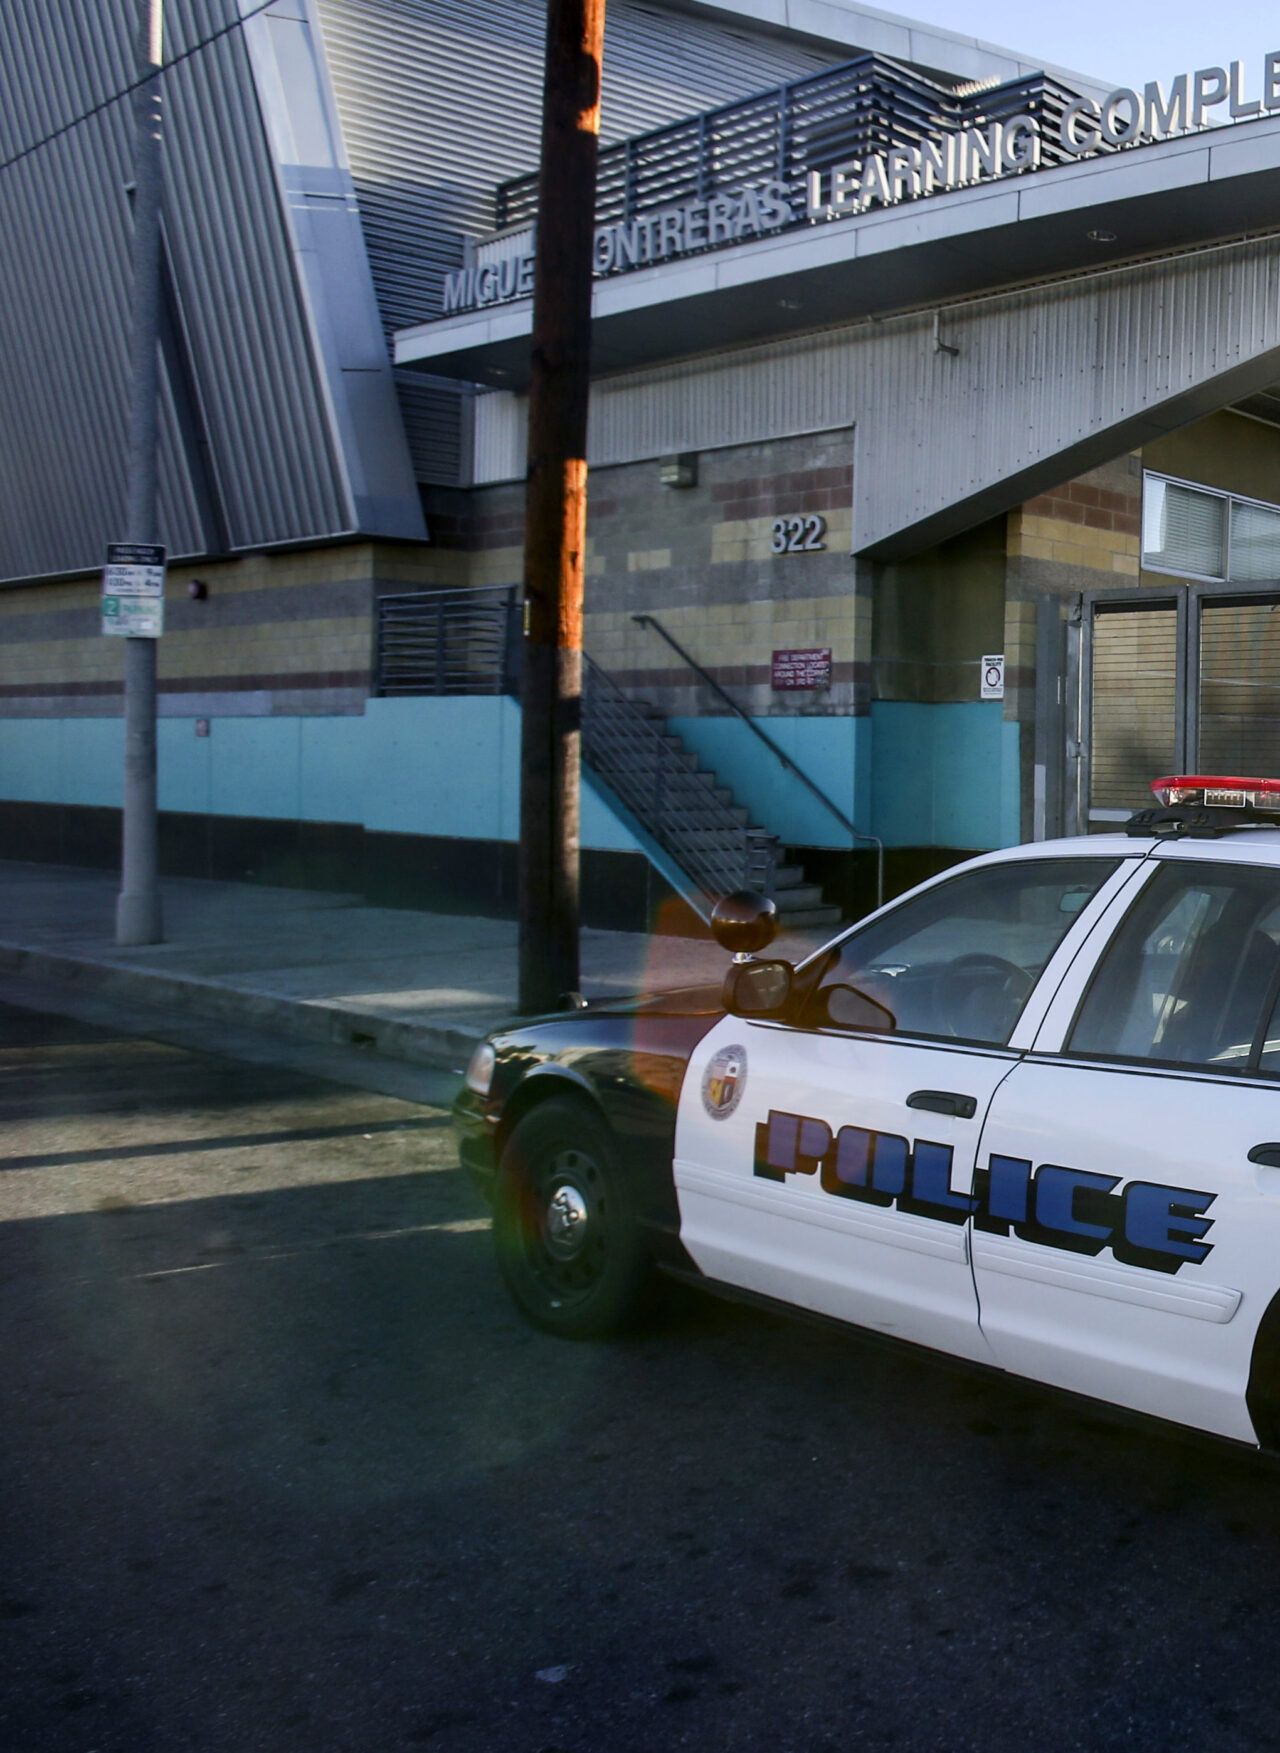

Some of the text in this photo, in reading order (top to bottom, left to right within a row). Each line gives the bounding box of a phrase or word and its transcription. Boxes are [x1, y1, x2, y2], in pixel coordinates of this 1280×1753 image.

[443, 254, 537, 313] MIGUE
[592, 181, 793, 274] ONTRERAS
[806, 113, 1041, 220] LEARNING
[771, 515, 827, 554] 322
[754, 1109, 1219, 1275] POLICE
